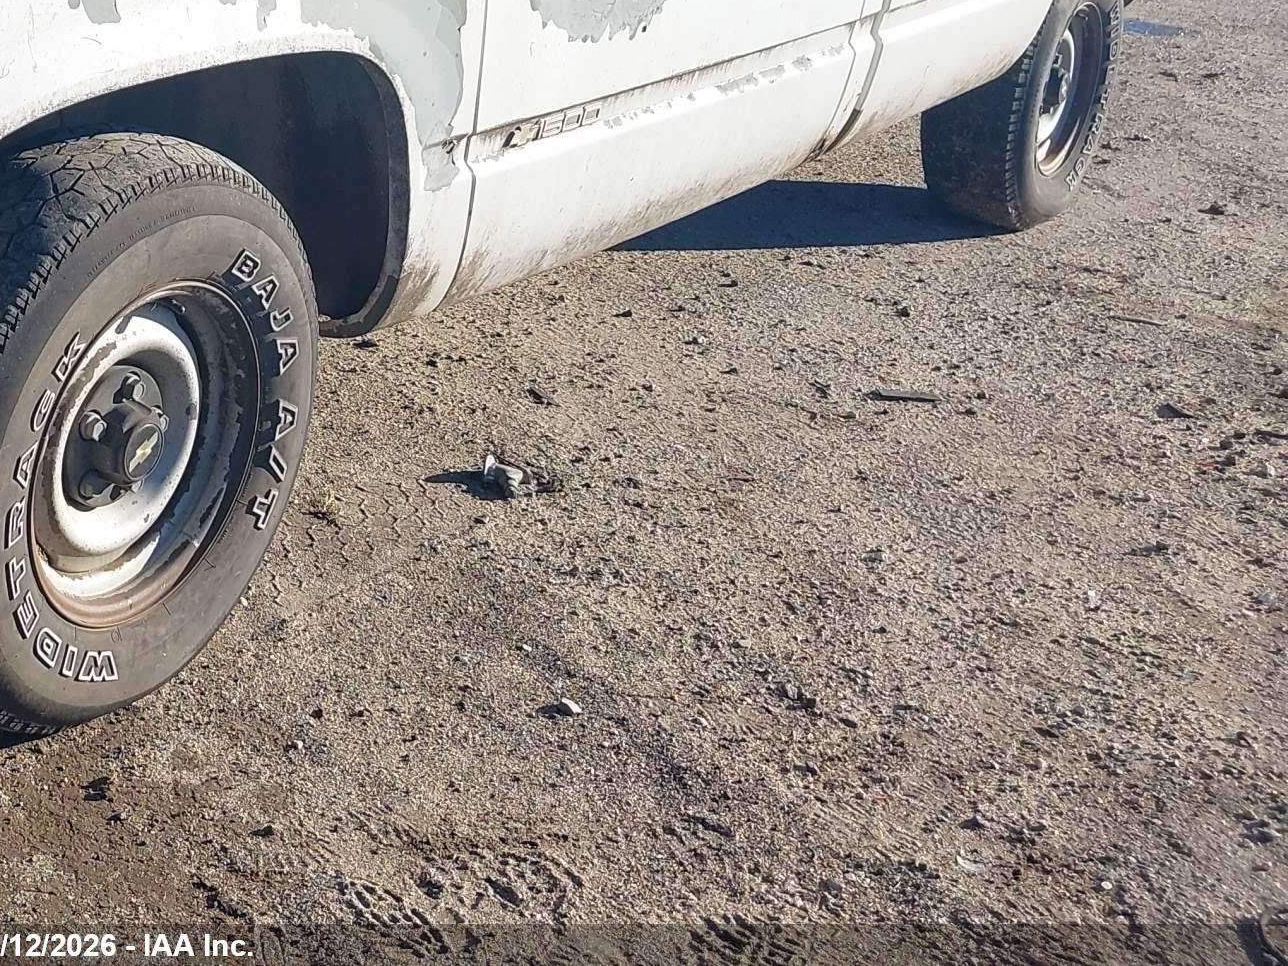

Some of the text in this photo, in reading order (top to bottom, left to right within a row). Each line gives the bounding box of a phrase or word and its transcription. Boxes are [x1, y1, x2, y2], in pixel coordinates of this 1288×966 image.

[4, 248, 299, 682] WIDETRACK BAJA A/T
